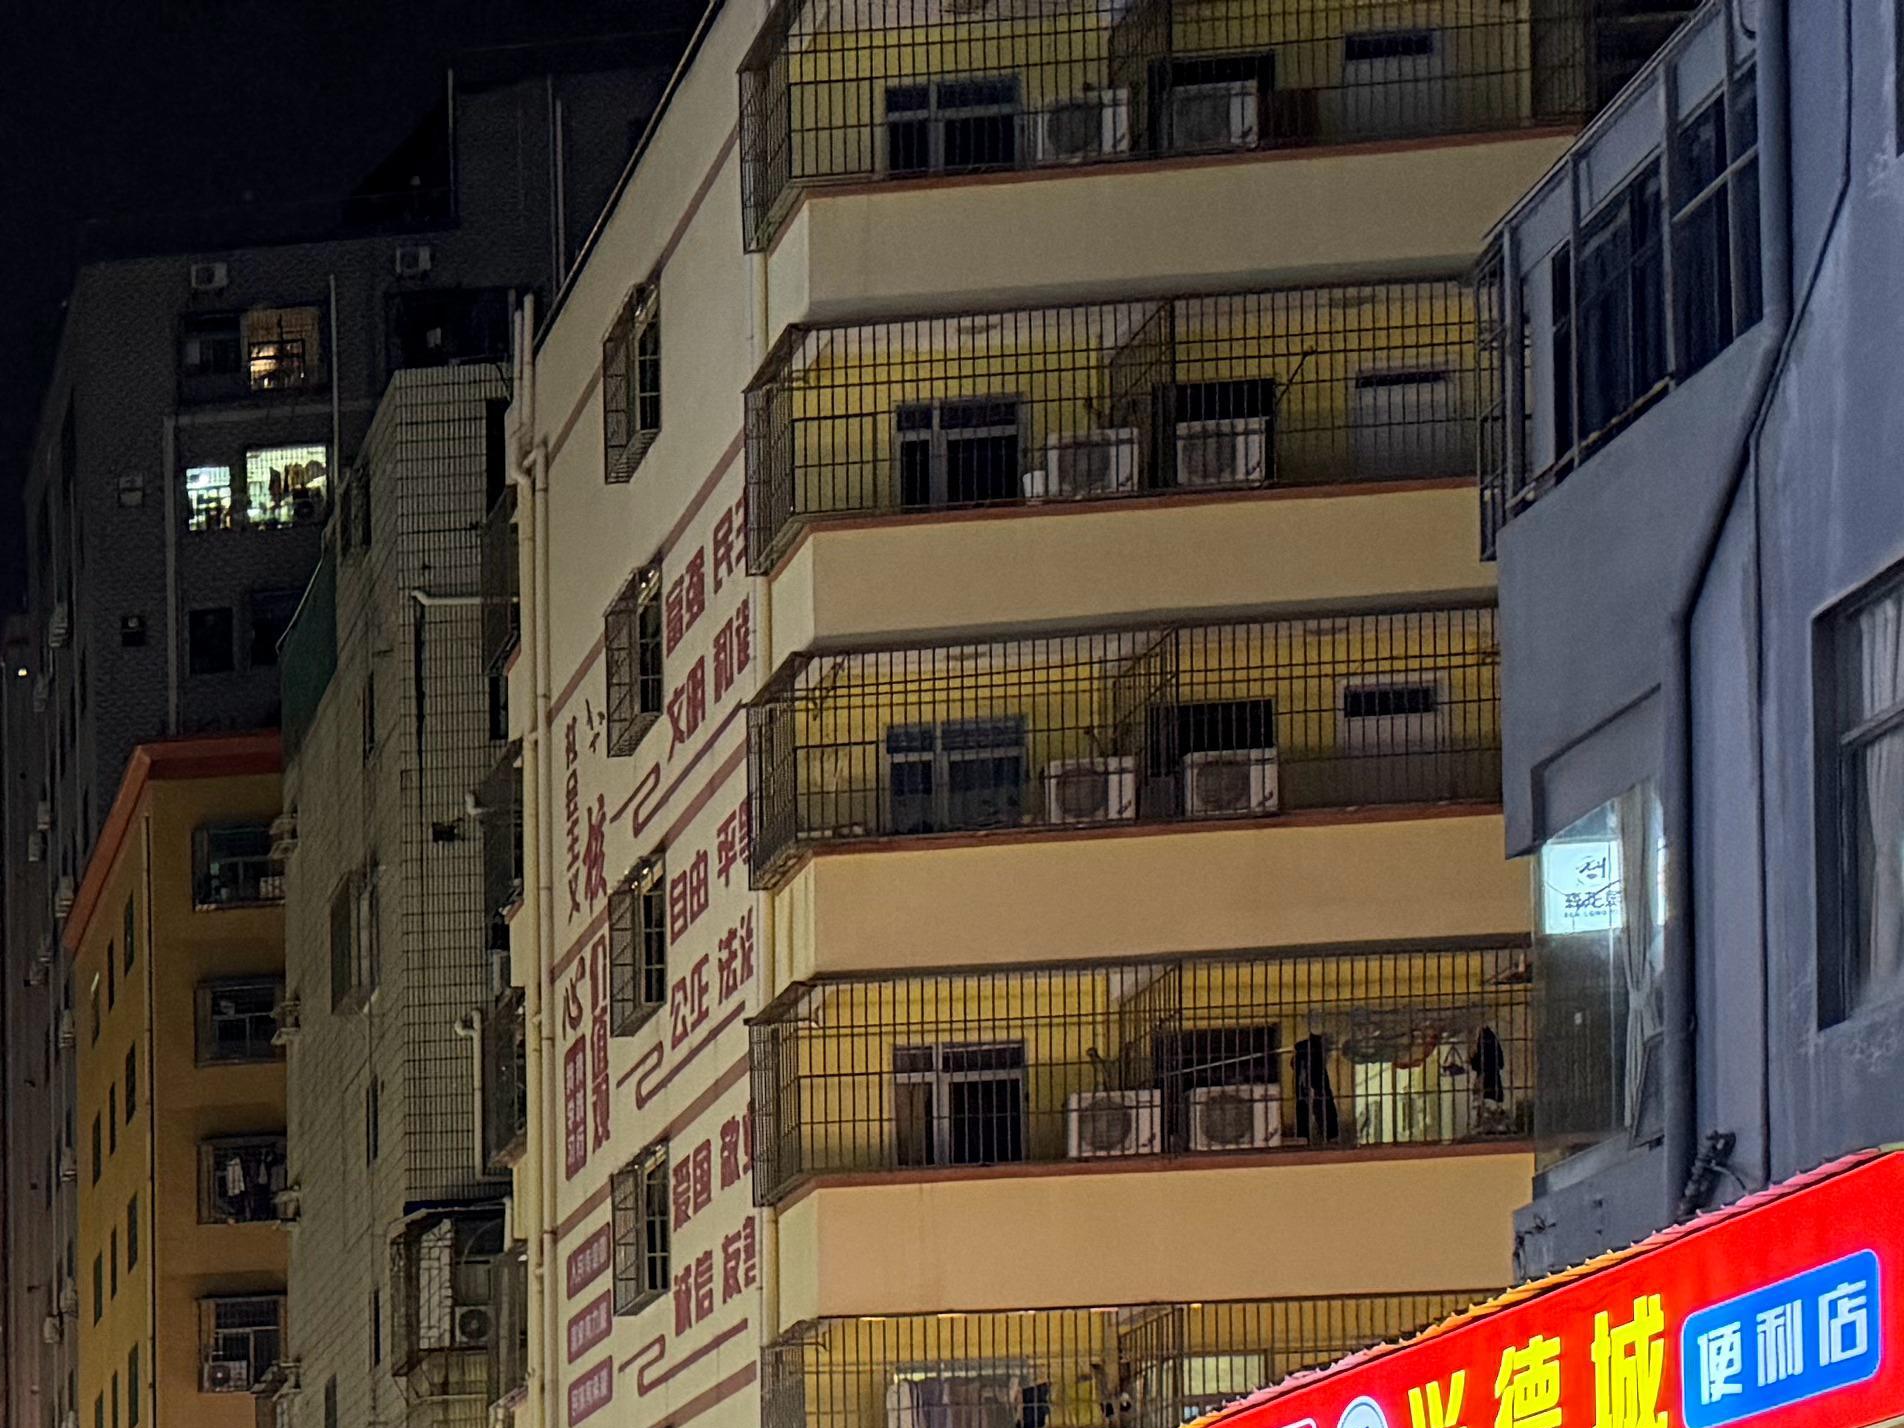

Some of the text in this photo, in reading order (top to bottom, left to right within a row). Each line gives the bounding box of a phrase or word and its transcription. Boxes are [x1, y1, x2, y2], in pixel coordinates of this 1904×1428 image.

[670, 850, 709, 945] 自由
[671, 953, 710, 1050] 公正
[1697, 1278, 1870, 1407] 便利店
